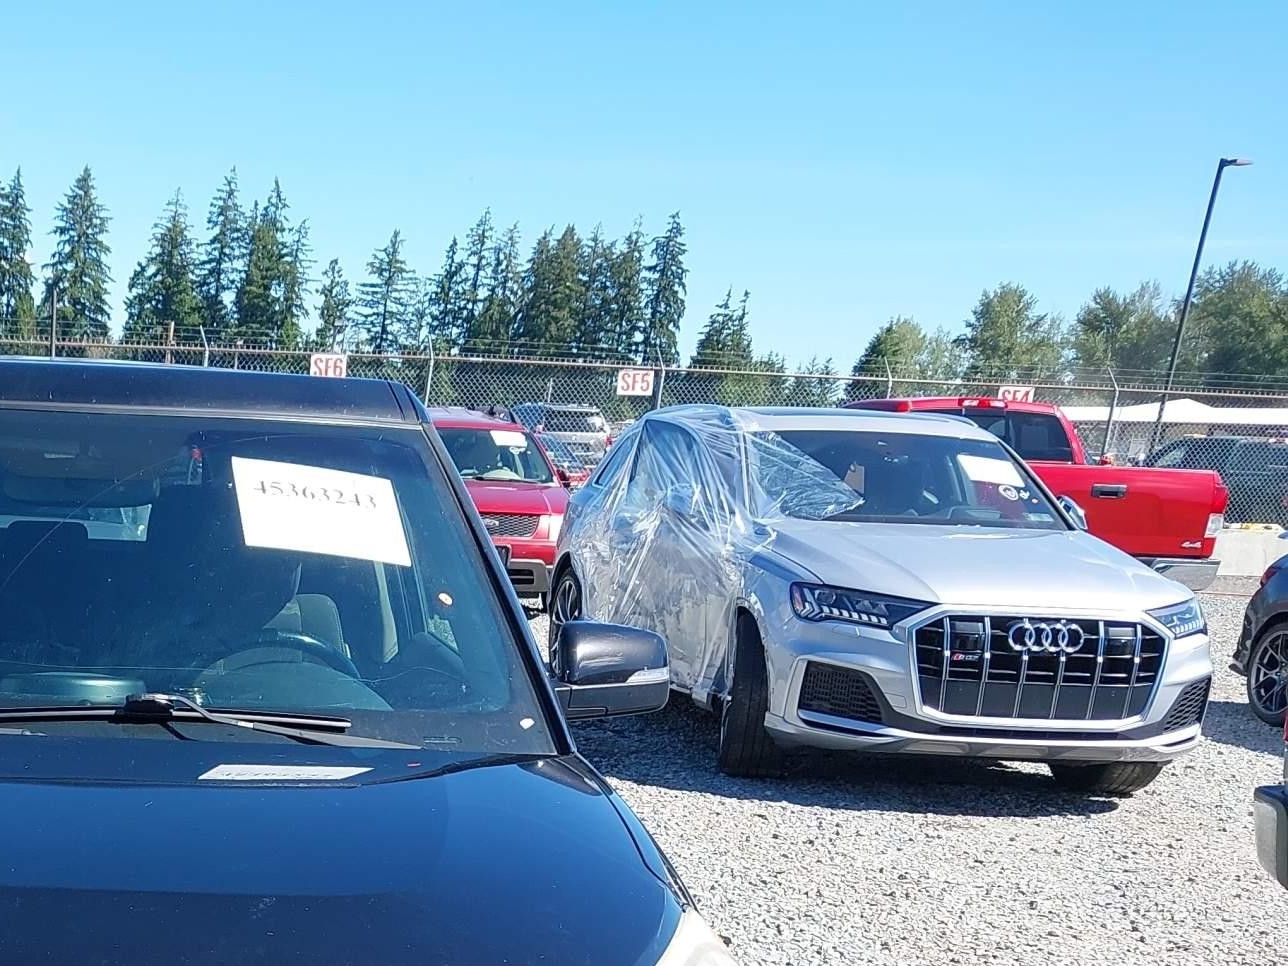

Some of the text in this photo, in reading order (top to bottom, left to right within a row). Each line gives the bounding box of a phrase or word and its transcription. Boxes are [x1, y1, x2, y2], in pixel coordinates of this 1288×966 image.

[313, 357, 344, 377] SF6
[620, 372, 651, 391] SF5
[253, 479, 377, 509] 45363243
